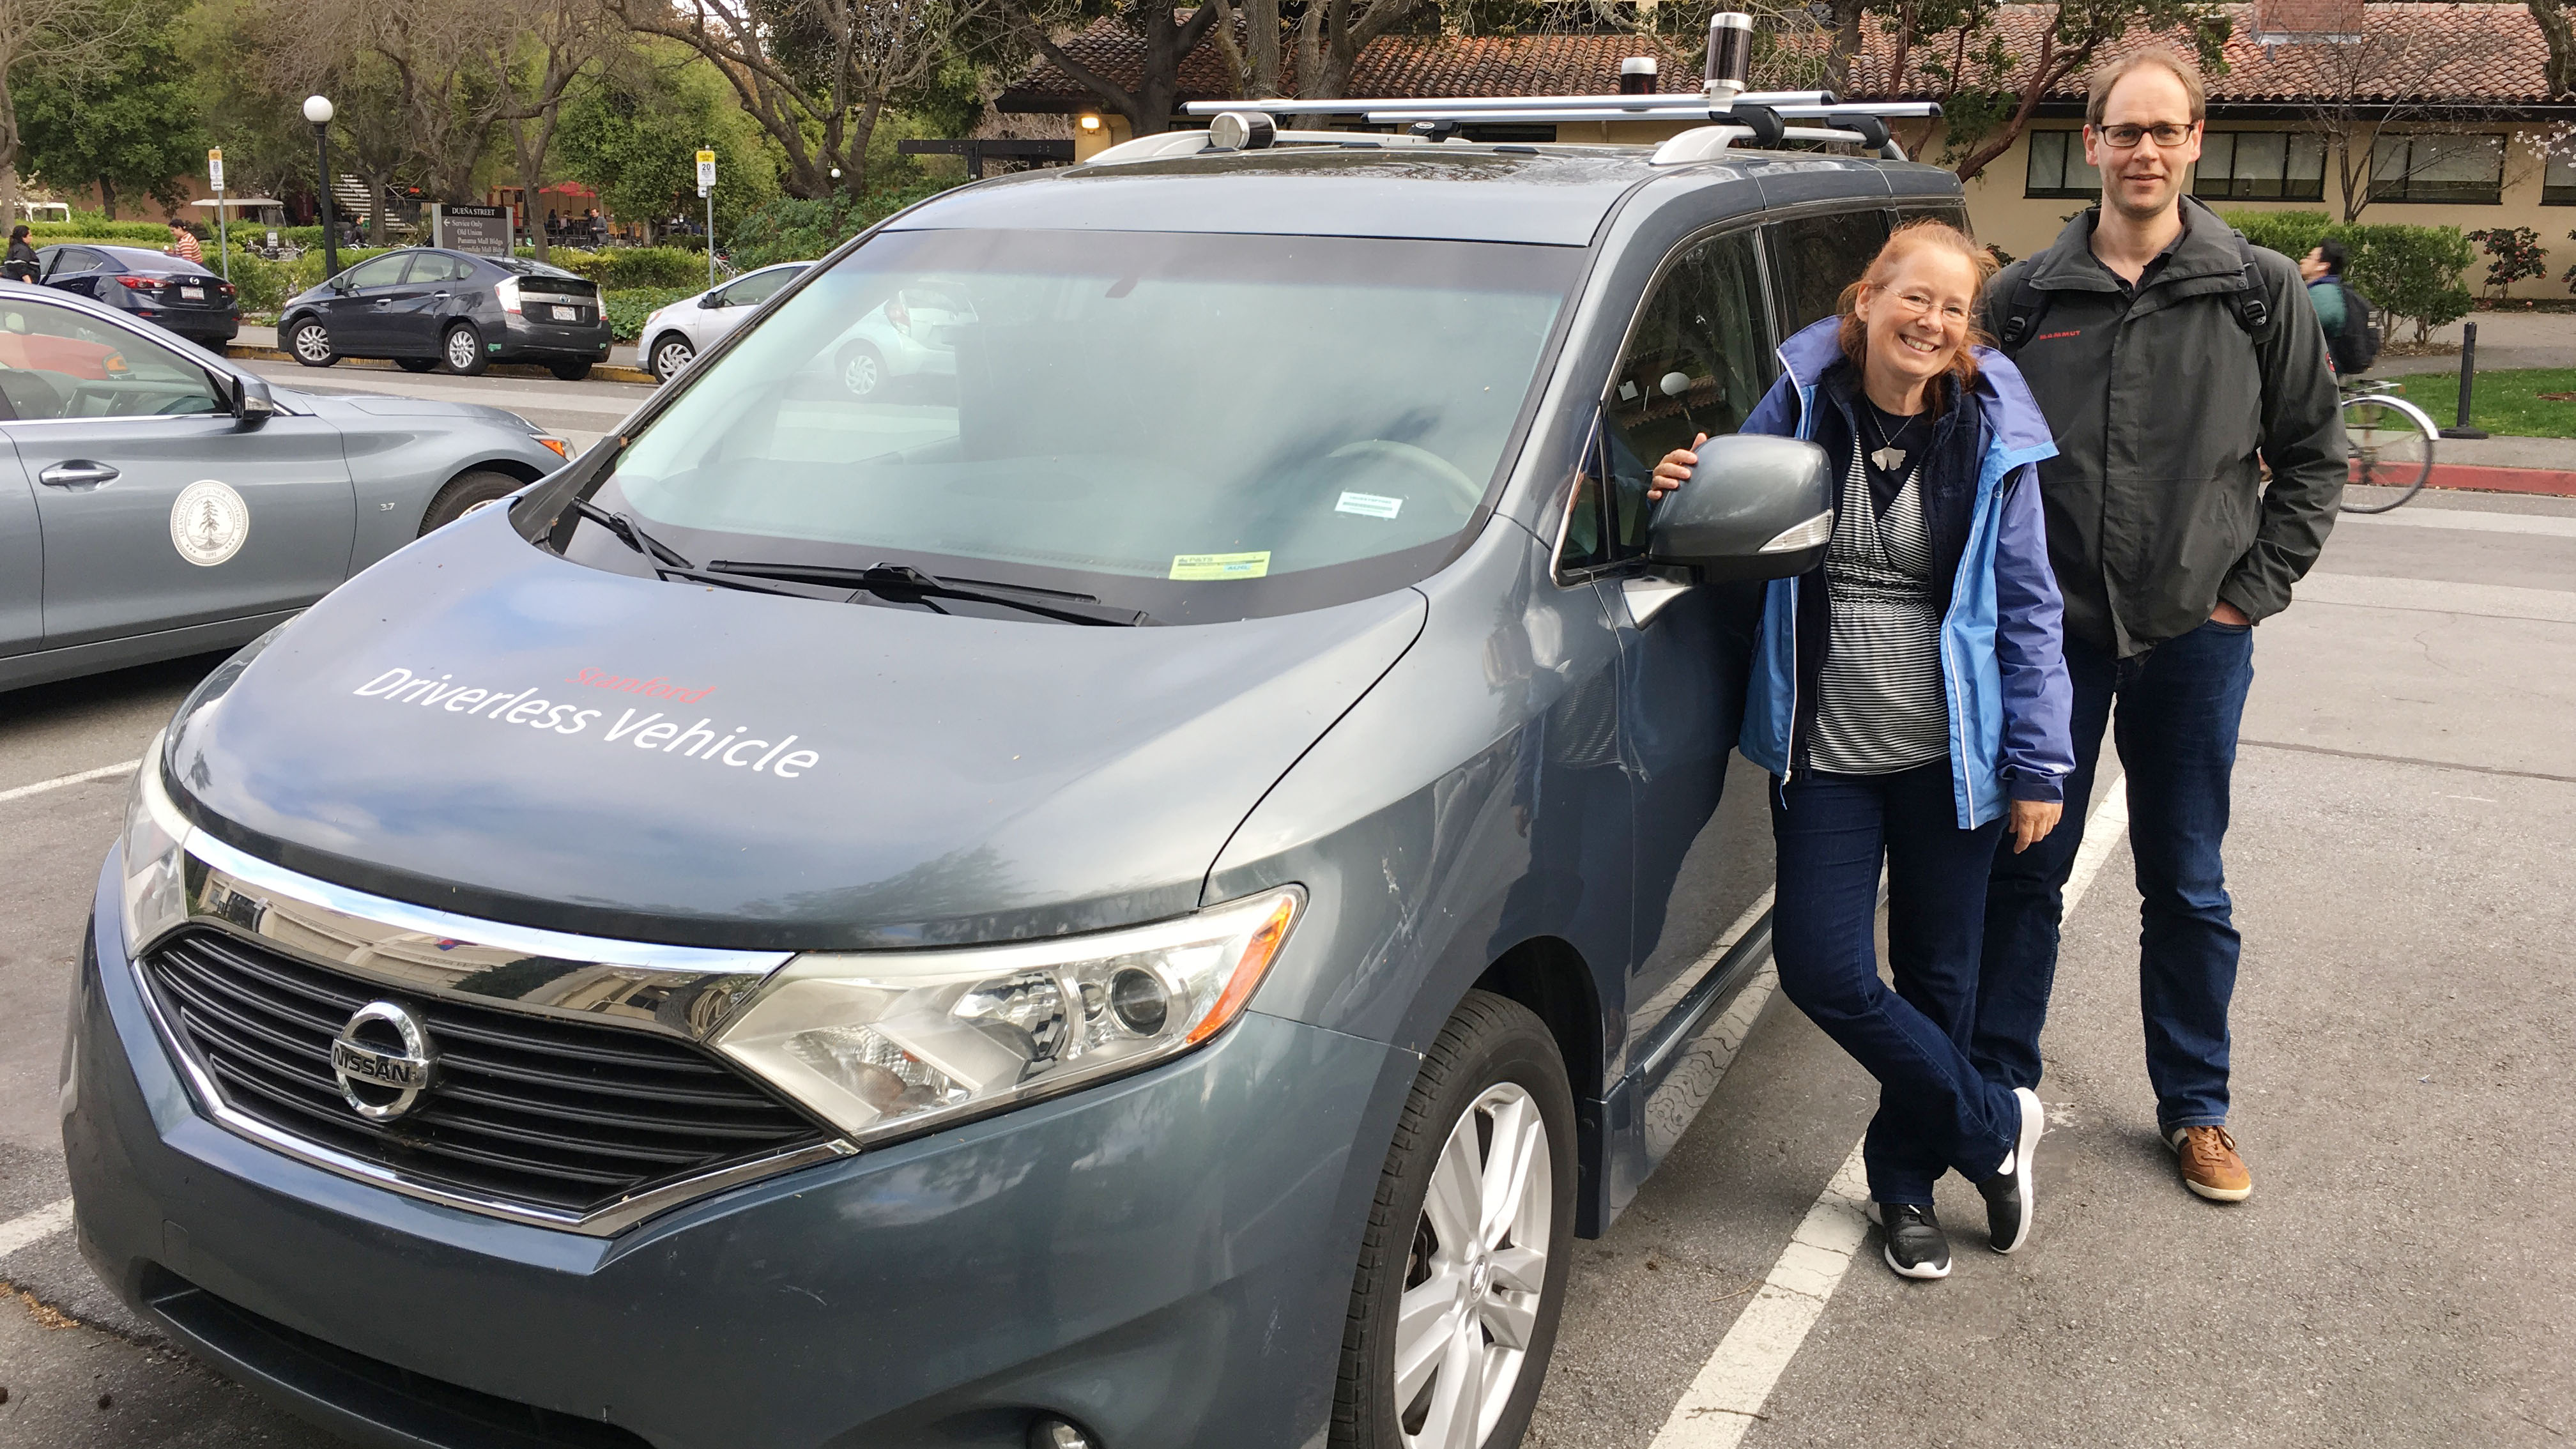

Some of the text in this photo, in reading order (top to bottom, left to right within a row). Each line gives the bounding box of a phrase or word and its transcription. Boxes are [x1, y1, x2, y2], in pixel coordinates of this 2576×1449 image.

[470, 220, 483, 229] Only
[2039, 330, 2081, 340] MAMMUT
[182, 488, 206, 511] STANFORD
[207, 488, 227, 498] JUNIOR
[227, 496, 242, 530] UNIVERSITY
[380, 502, 395, 511] 3.7
[564, 666, 716, 704] Stanford
[352, 668, 820, 778] Driverless Vehicle
[333, 1046, 410, 1084] NISSAN
